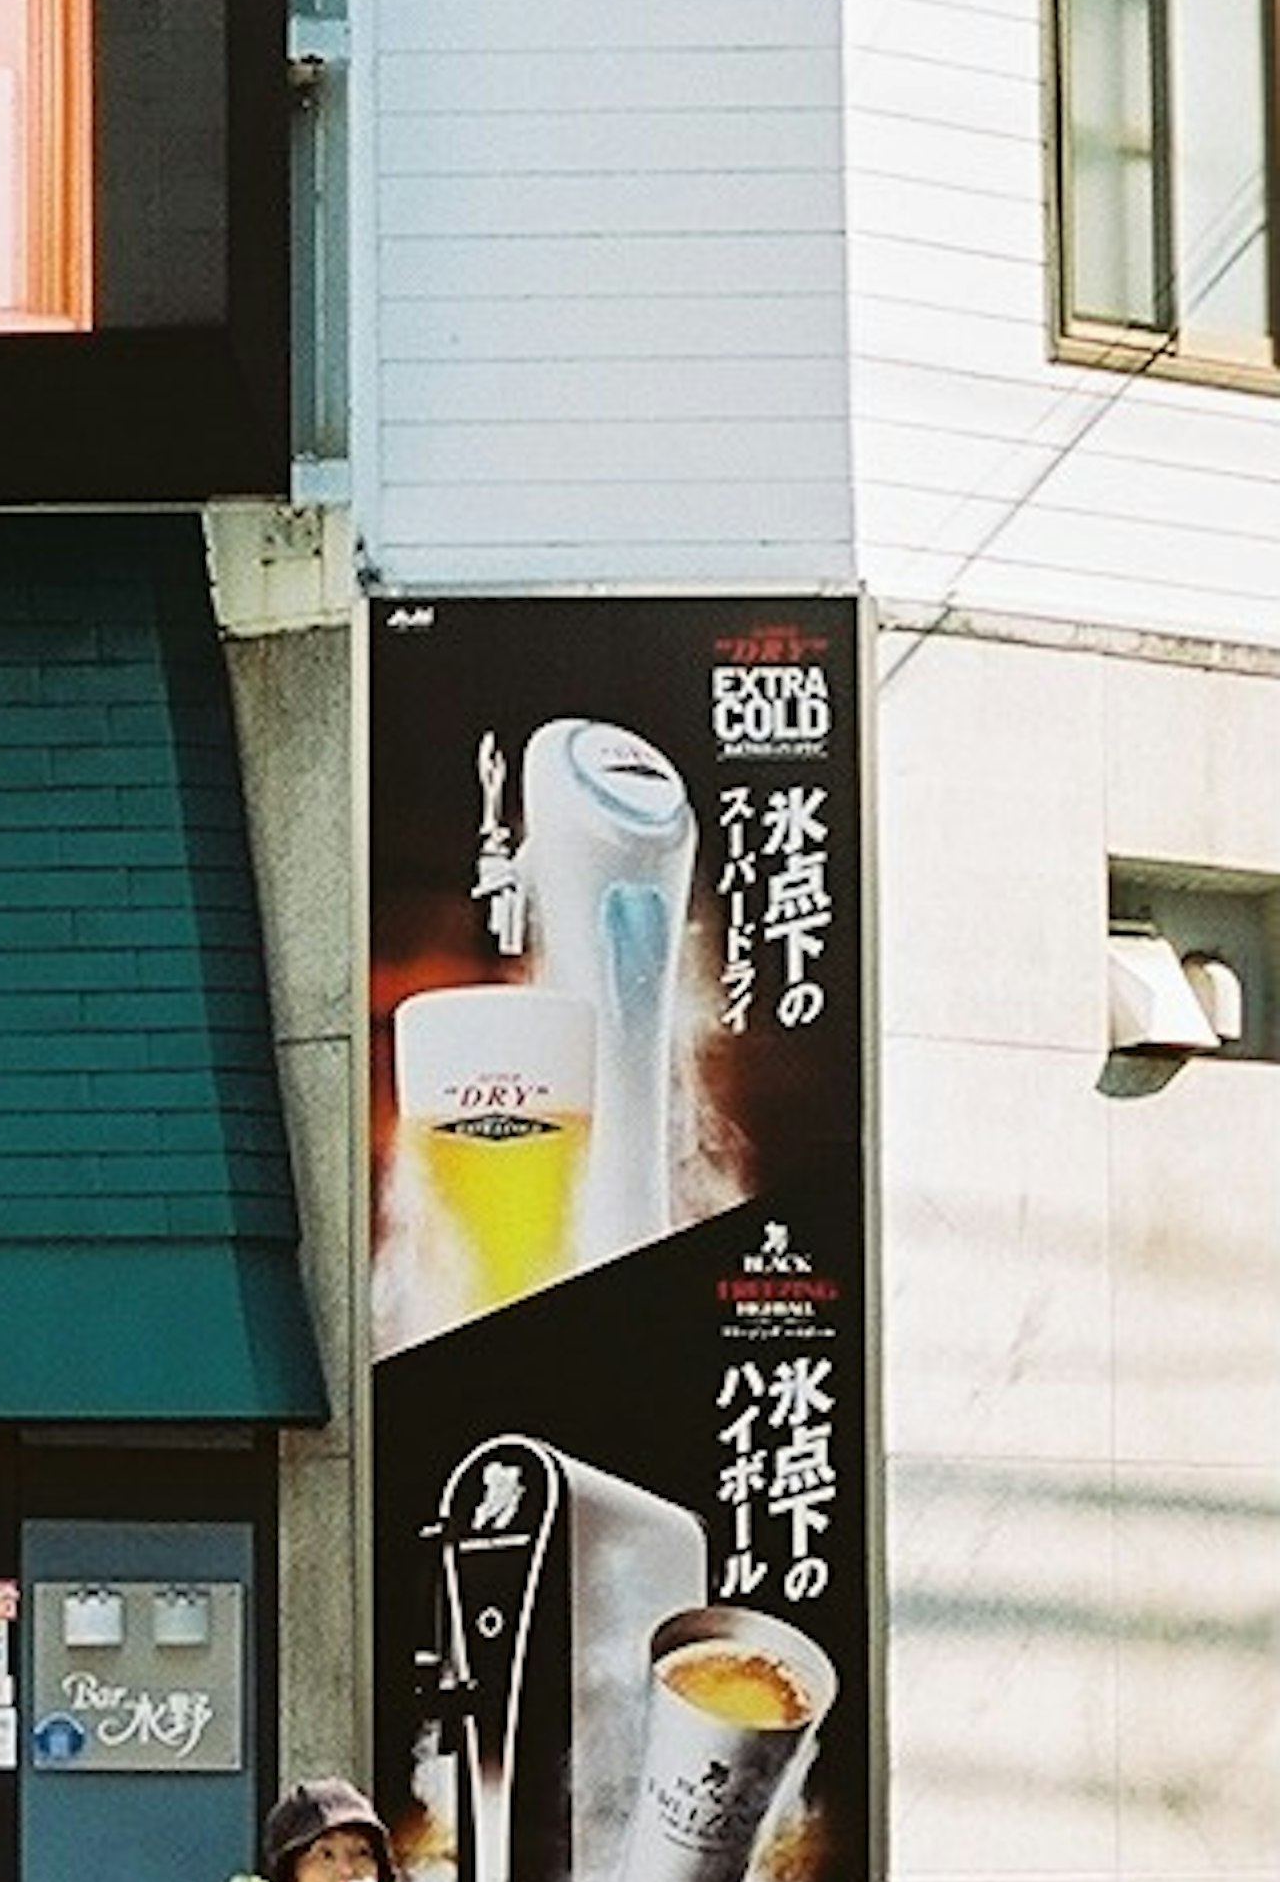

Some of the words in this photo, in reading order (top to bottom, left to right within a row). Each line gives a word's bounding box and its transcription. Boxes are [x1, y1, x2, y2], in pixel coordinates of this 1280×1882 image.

[711, 665, 829, 699] EXTRA
[713, 697, 832, 743] COLD
[717, 786, 757, 1035] スーパードライ
[761, 786, 832, 1027] 氷点下の
[716, 1361, 768, 1598] ハイボール
[768, 1356, 837, 1603] 氷点下の
[61, 1672, 129, 1710] Bar
